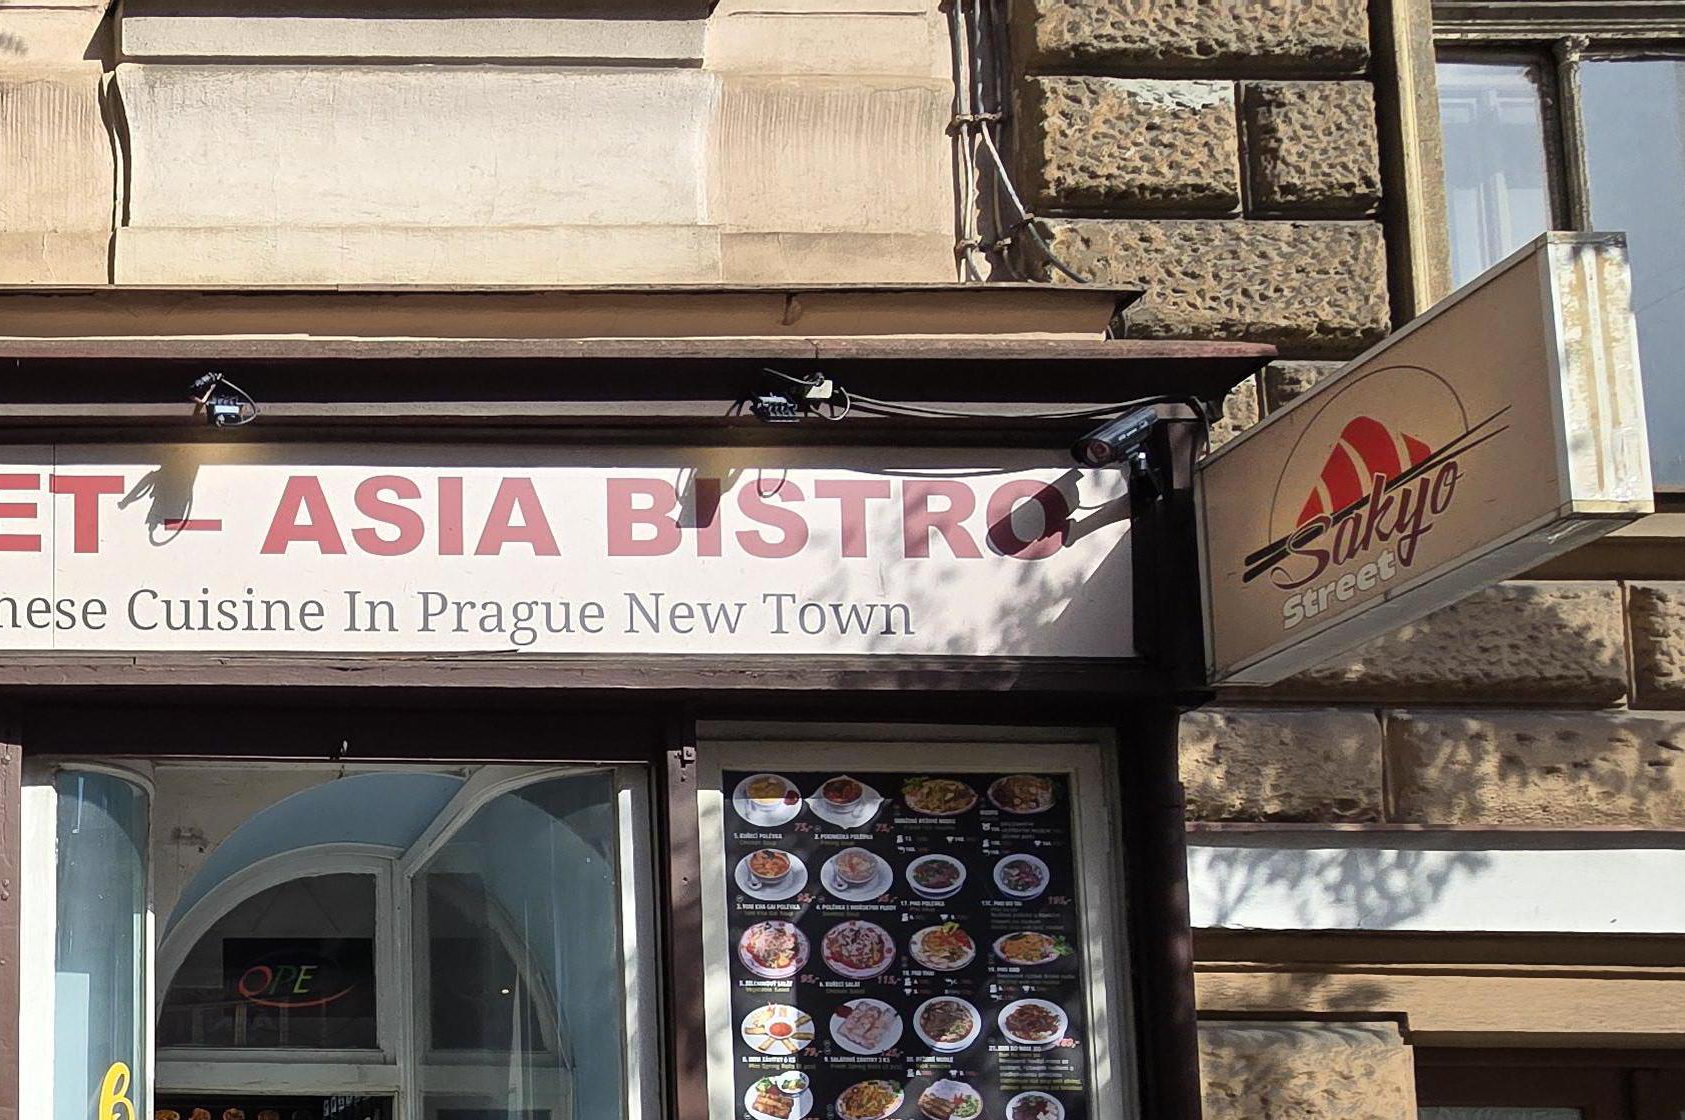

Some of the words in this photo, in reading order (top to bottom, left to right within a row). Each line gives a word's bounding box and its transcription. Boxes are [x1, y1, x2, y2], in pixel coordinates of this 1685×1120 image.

[259, 475, 562, 557] ASIA
[606, 477, 1072, 560] BISTRO
[1271, 460, 1464, 590] Sakyo
[128, 587, 325, 633] Cuisine
[344, 590, 396, 633] In
[418, 591, 605, 646] Prague
[624, 593, 744, 636] New
[763, 593, 915, 637] Town
[1283, 549, 1397, 630] Street
